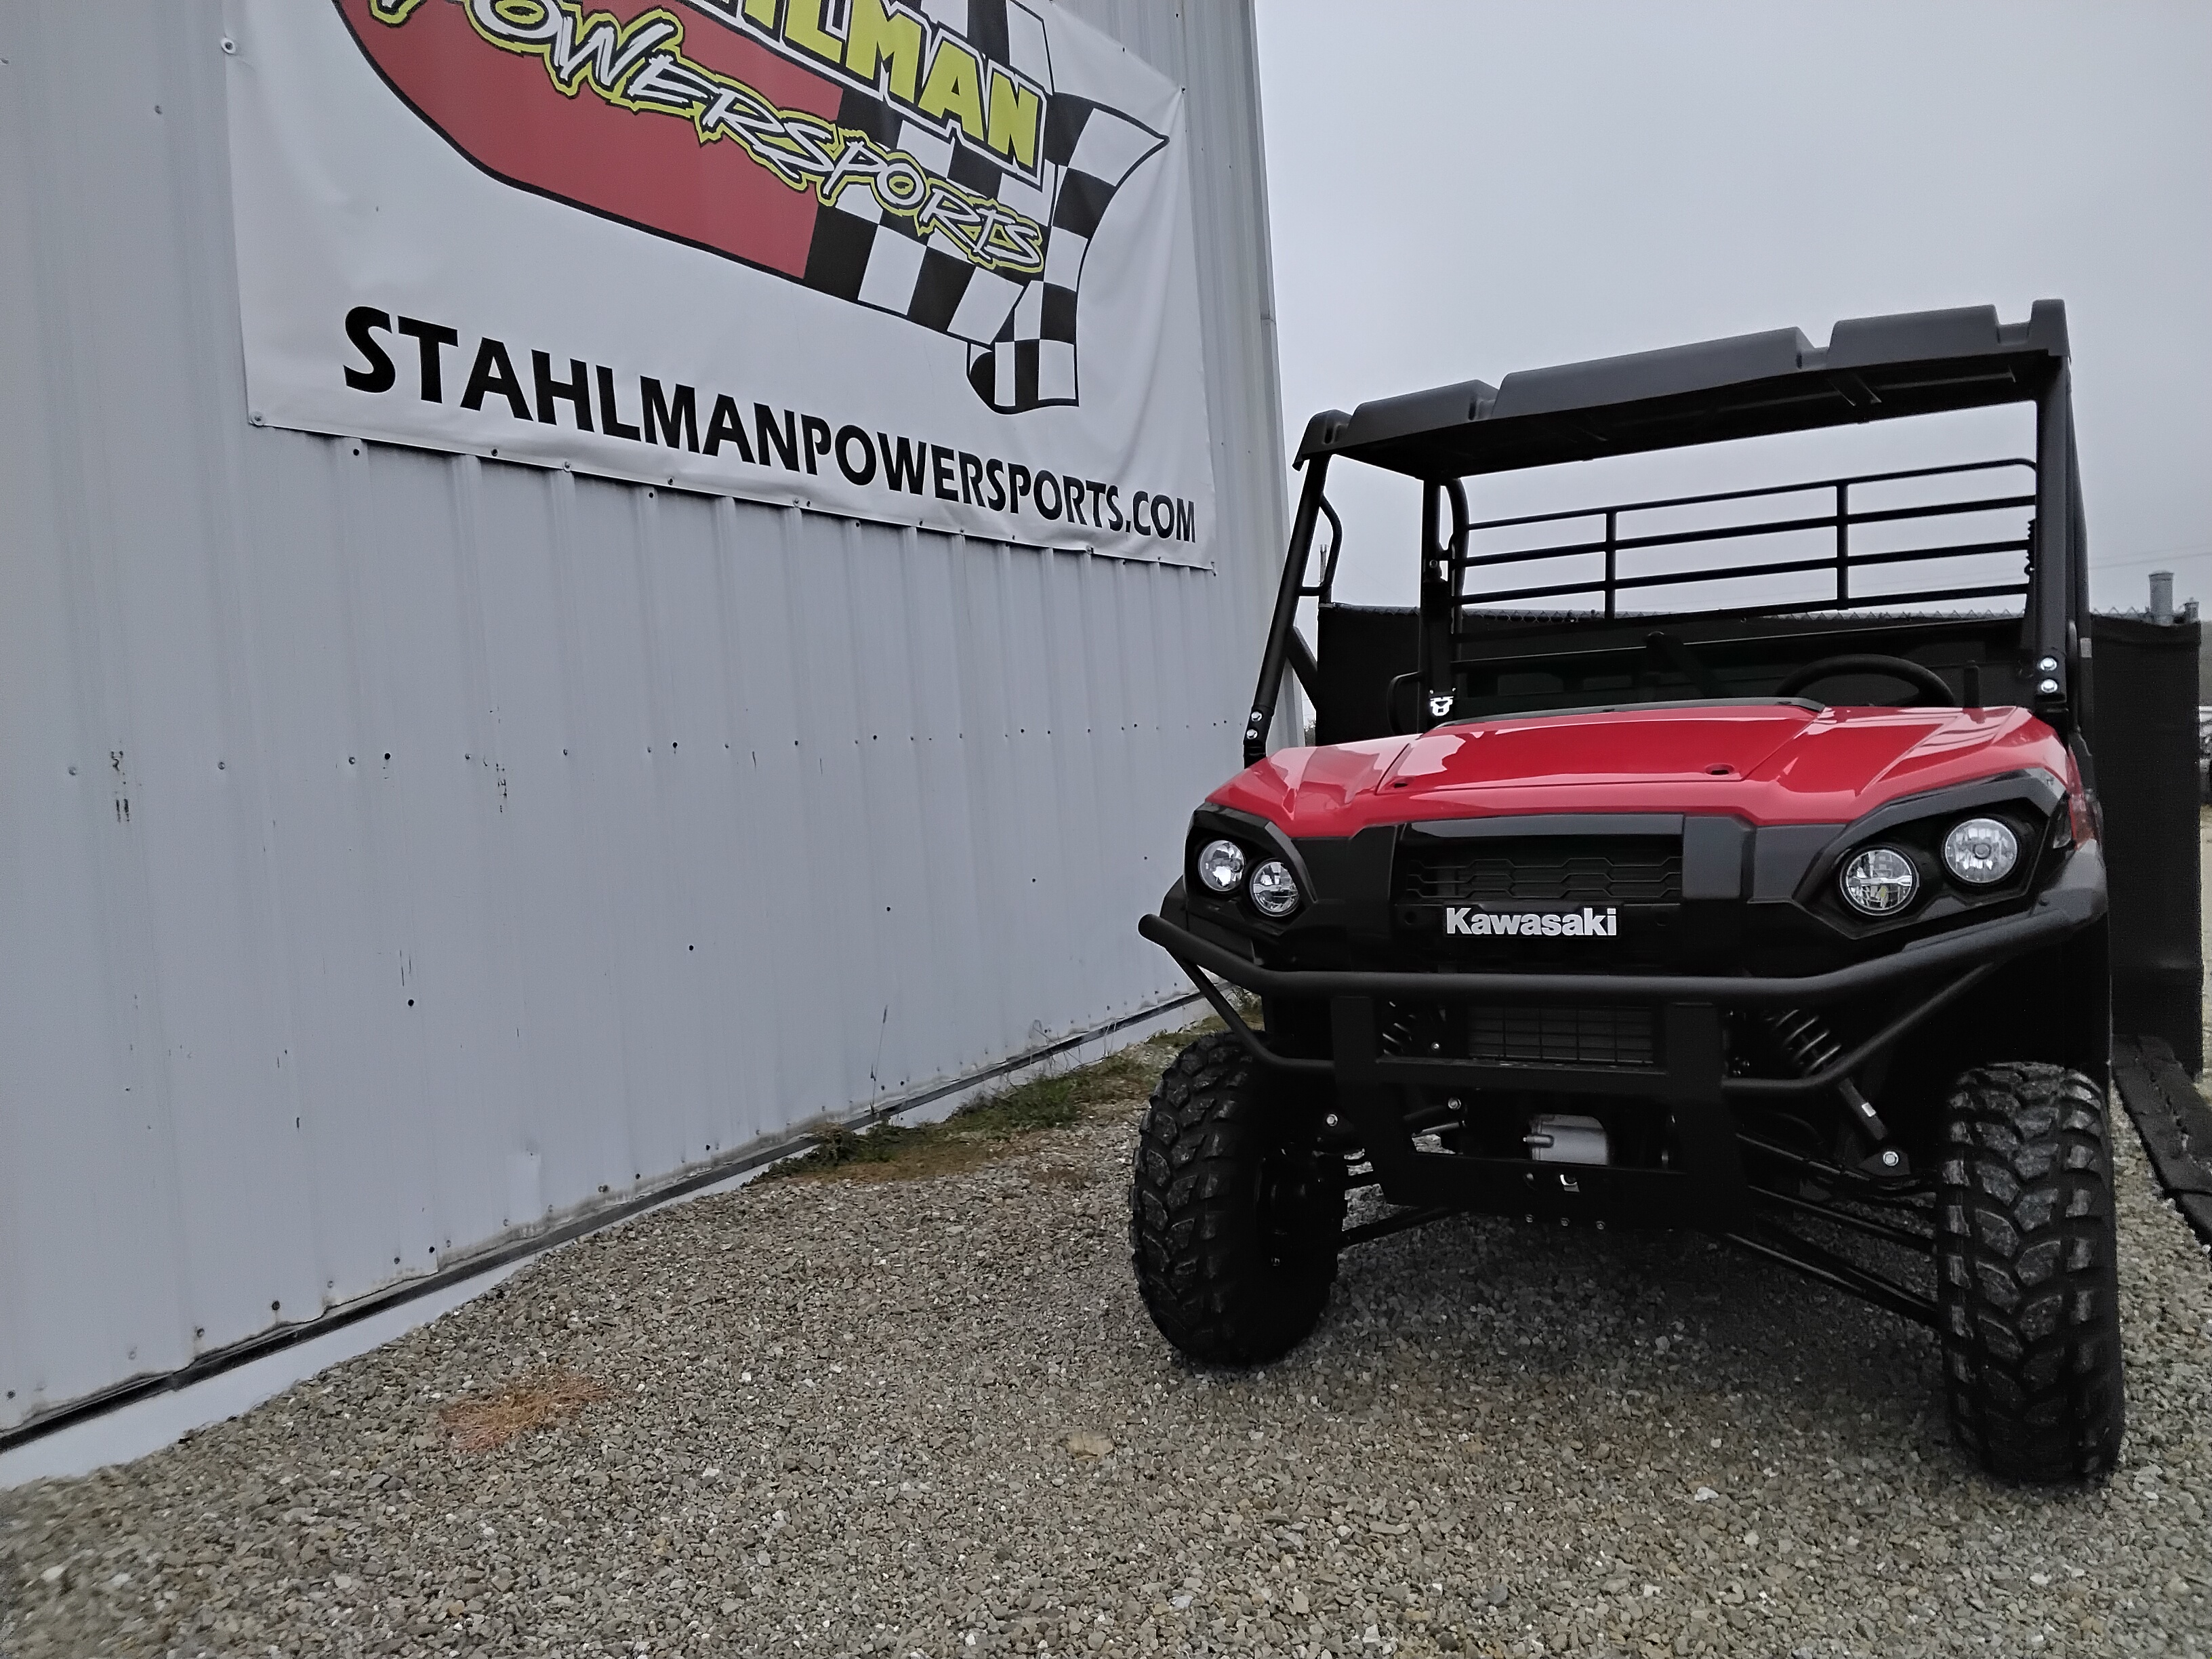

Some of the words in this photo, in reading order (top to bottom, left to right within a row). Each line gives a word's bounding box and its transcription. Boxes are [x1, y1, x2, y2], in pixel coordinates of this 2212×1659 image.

[370, 0, 1044, 270] OWERSPORTS
[721, 0, 1040, 169] LMAN
[344, 306, 1195, 543] STAHLMANPOWERSPORTS.COM
[1446, 907, 1617, 936] Kawasaki
